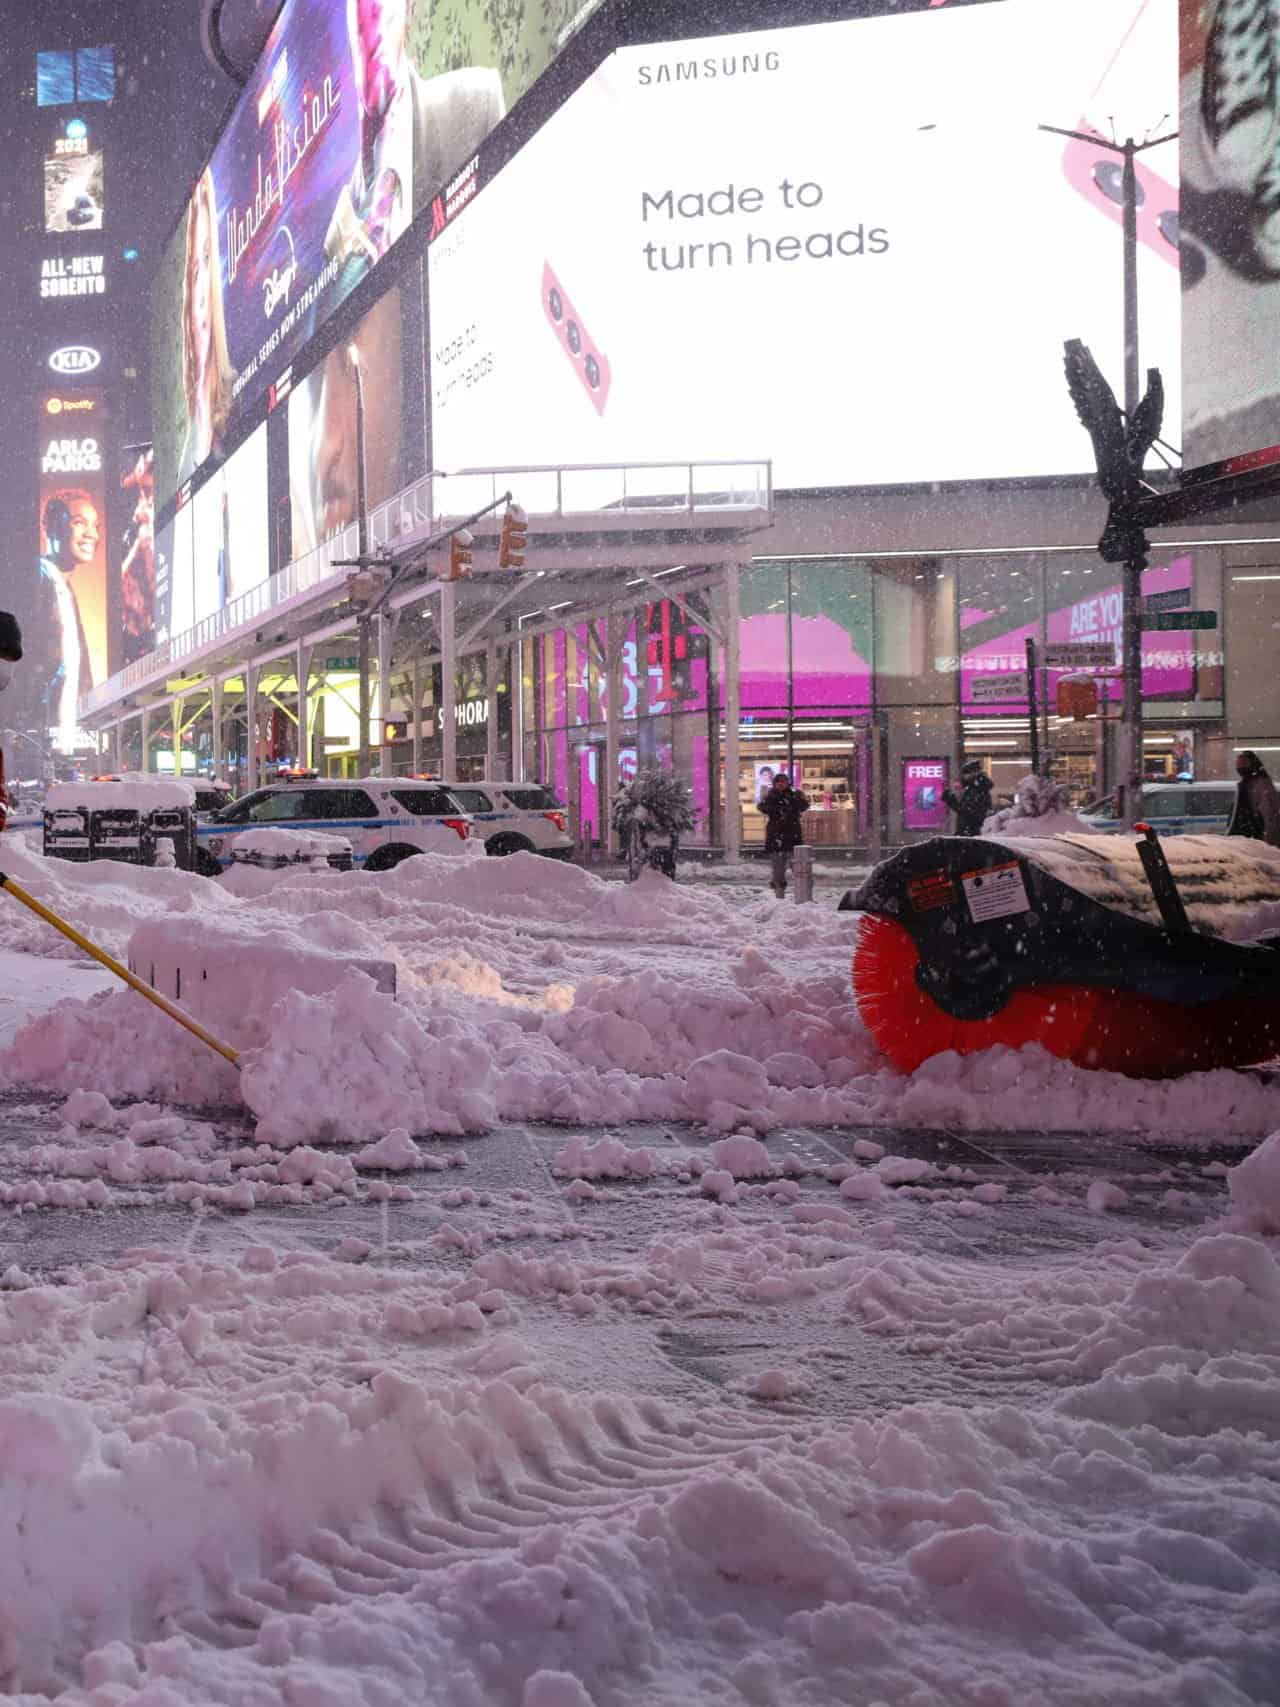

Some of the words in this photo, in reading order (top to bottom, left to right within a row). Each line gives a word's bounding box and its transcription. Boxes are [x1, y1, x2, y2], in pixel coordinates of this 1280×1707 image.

[637, 51, 780, 86] SAMSUNG
[642, 184, 764, 222] Made
[779, 178, 824, 209] to
[642, 240, 733, 272] turn
[747, 223, 890, 264] heads
[41, 255, 104, 278] ALL-NEW
[296, 255, 338, 319] STREAMING
[46, 438, 98, 457] ARLO
[908, 765, 943, 779] FREE
